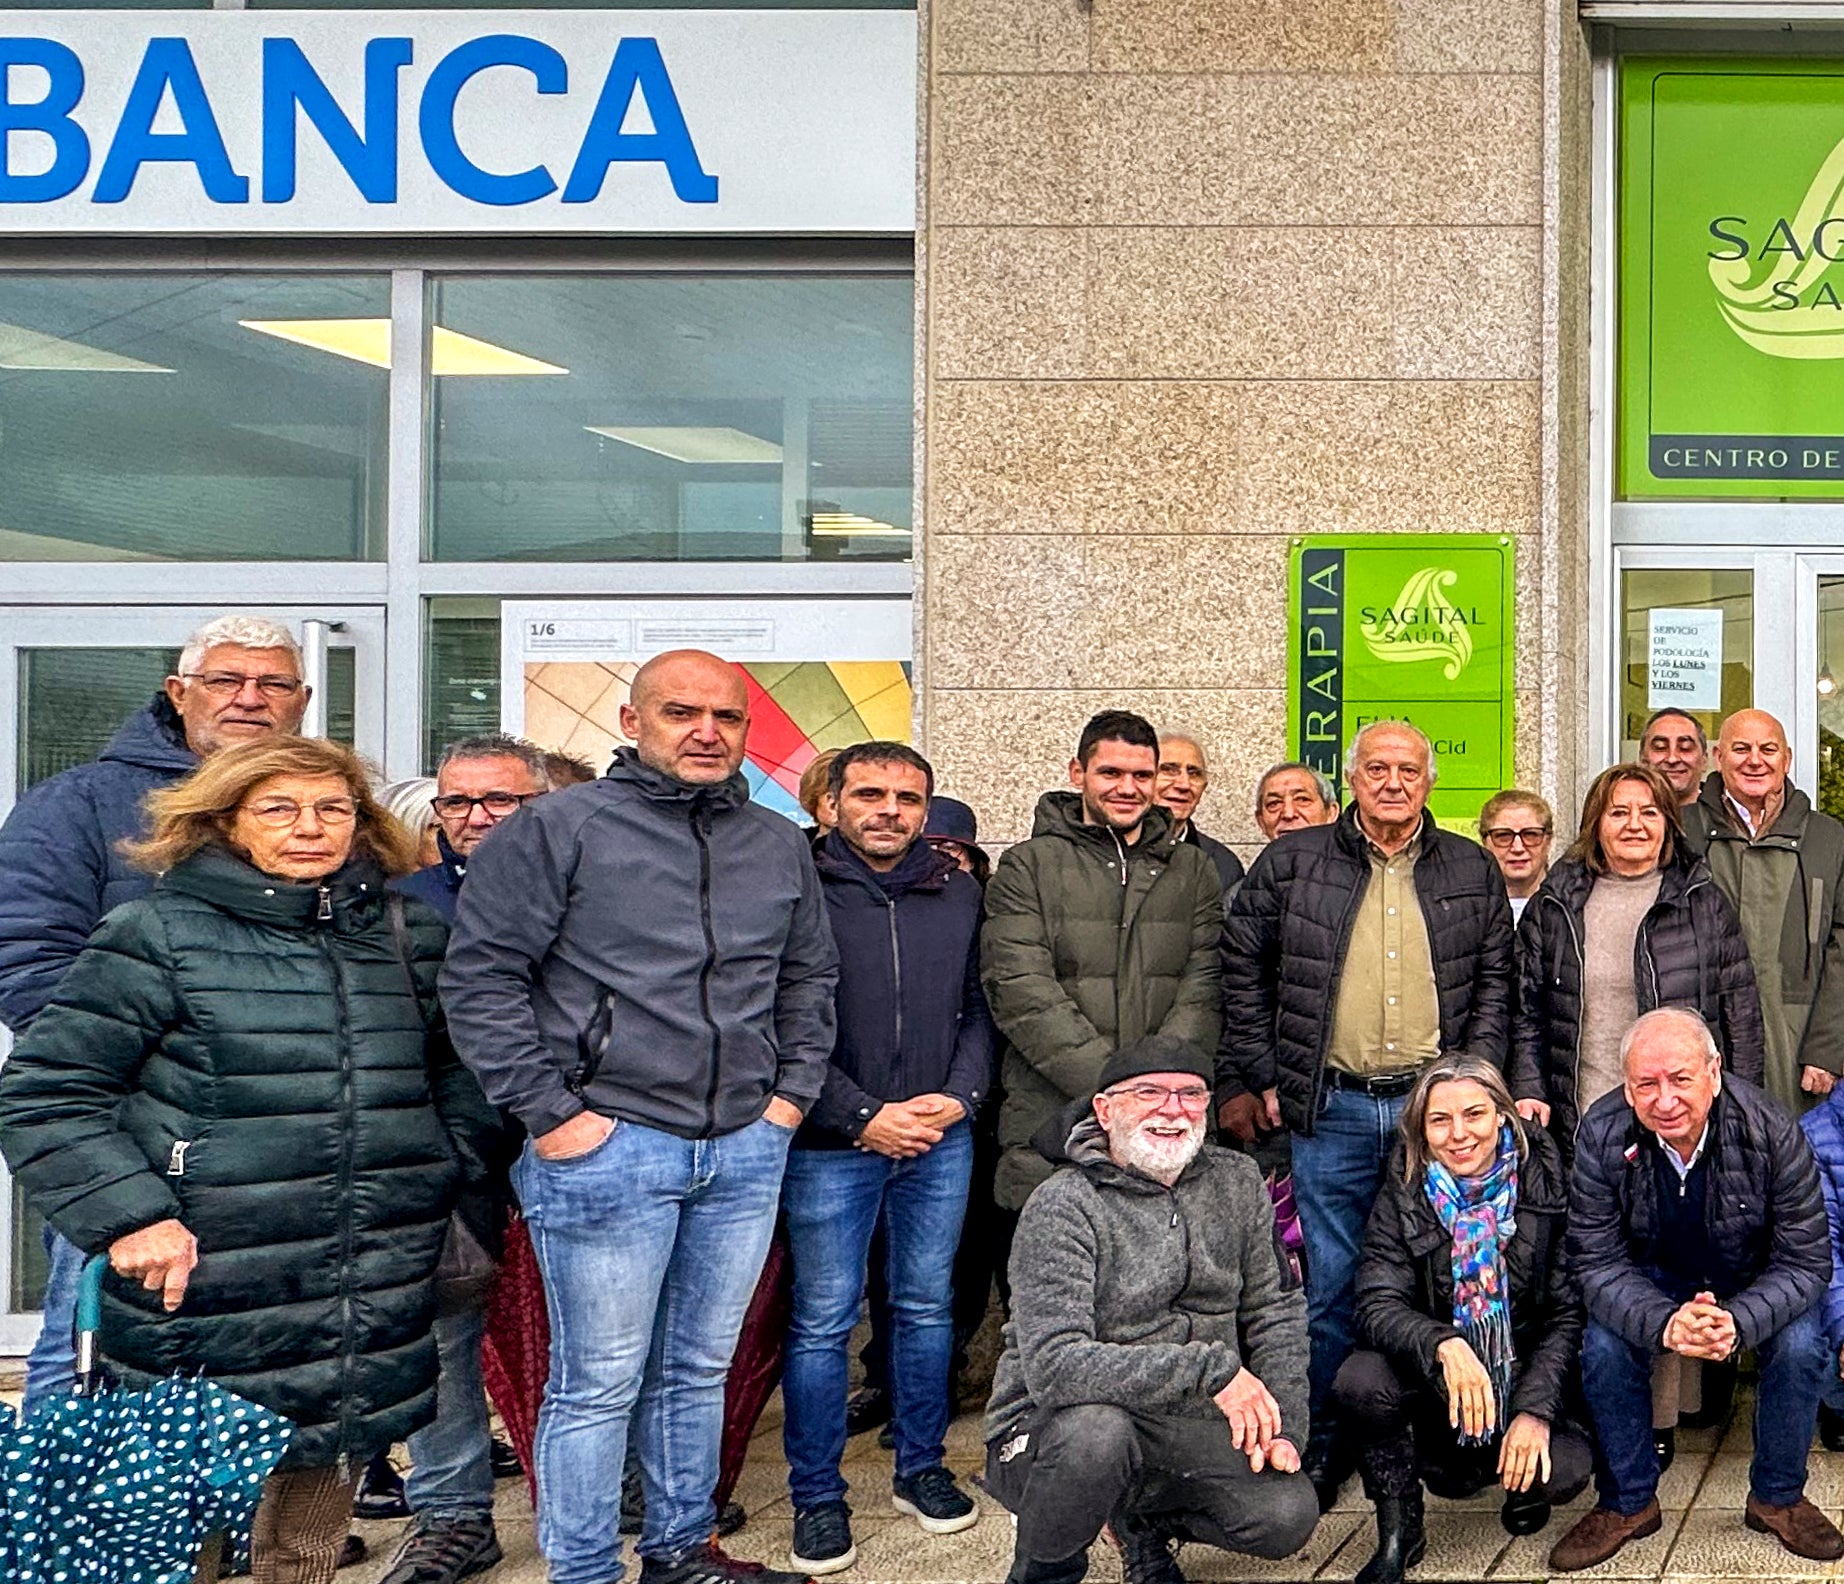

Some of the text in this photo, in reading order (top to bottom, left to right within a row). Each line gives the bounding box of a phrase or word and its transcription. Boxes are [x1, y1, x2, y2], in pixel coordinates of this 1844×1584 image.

[0, 34, 719, 206] BANCA
[1663, 448, 1788, 469] CENTRO
[1803, 449, 1841, 469] DE
[1360, 607, 1486, 625] SAGITAL
[531, 623, 555, 636] 1/6
[1653, 626, 1698, 635] SERVICIO
[1384, 628, 1460, 644] SAÚDE
[1653, 636, 1666, 645] DE
[1653, 647, 1710, 658] PODOLOGÍA
[1652, 659, 1706, 670] LOS LUNES
[1652, 669, 1680, 678] Y LOS
[1651, 681, 1696, 691] VIERNES
